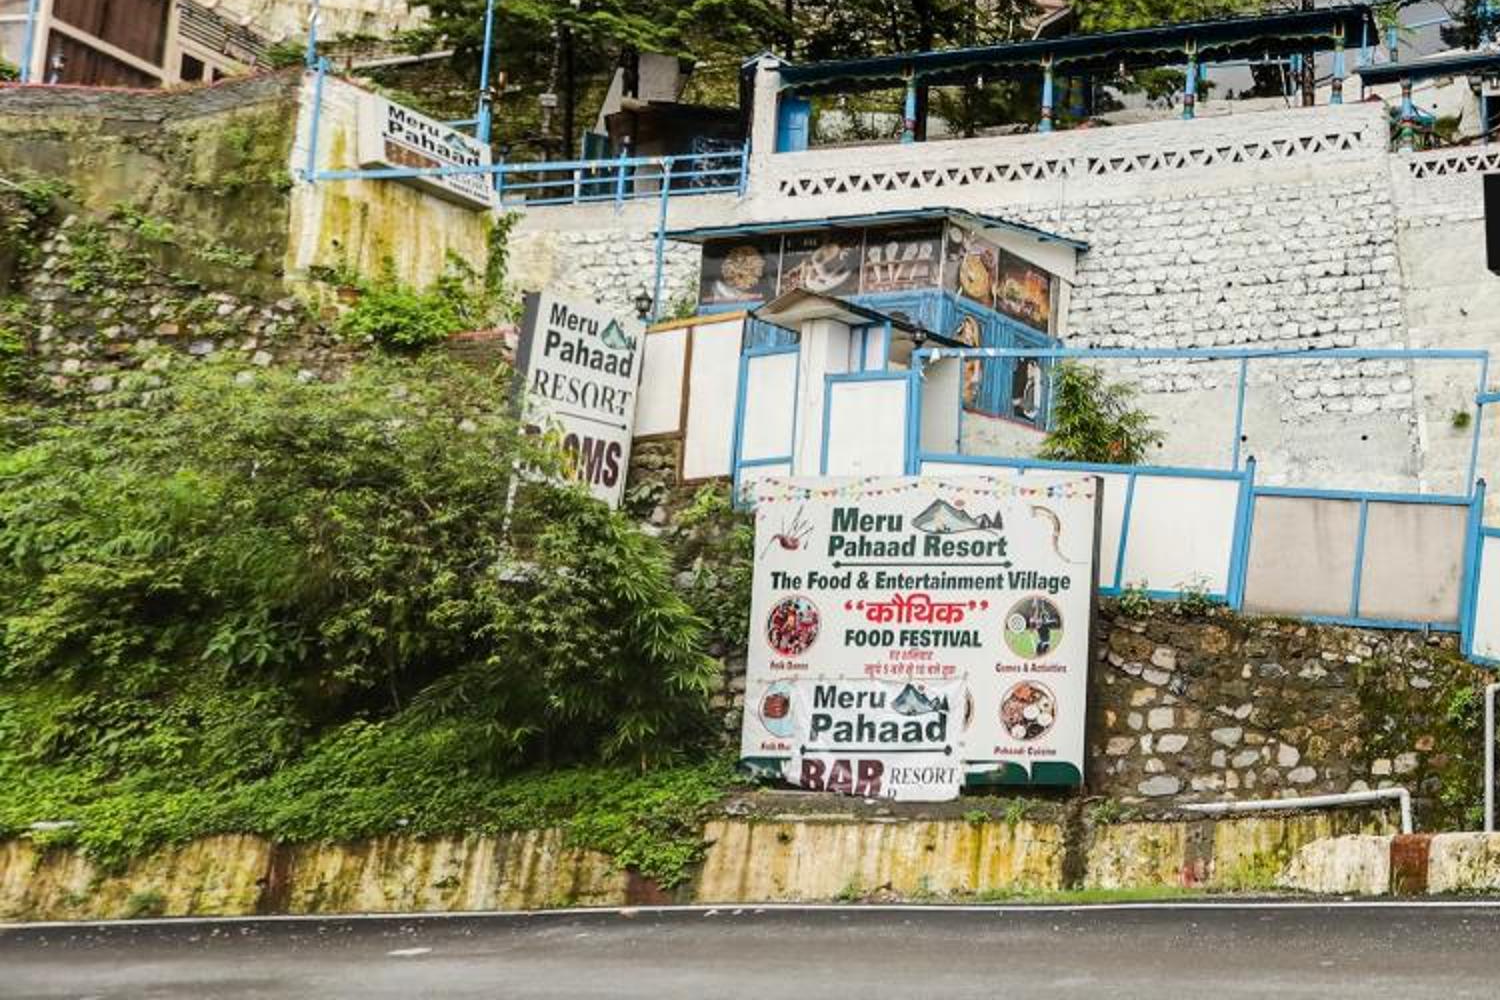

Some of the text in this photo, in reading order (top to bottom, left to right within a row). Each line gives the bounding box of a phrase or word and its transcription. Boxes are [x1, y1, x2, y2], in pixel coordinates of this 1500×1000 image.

[388, 106, 440, 138] Meru
[549, 302, 599, 337] Meru
[544, 330, 634, 379] Pahaad
[531, 369, 632, 415] RESORT
[525, 423, 622, 489] OMS
[831, 507, 903, 533] Meru
[828, 535, 1008, 557] Pahaad Resort
[771, 572, 1071, 594] The Food & Entertainment Village
[845, 629, 982, 647] FOOD FESTIVAL
[813, 685, 886, 709] Meru
[809, 711, 948, 743] Pahaad
[800, 758, 957, 796] BAR RESORT
